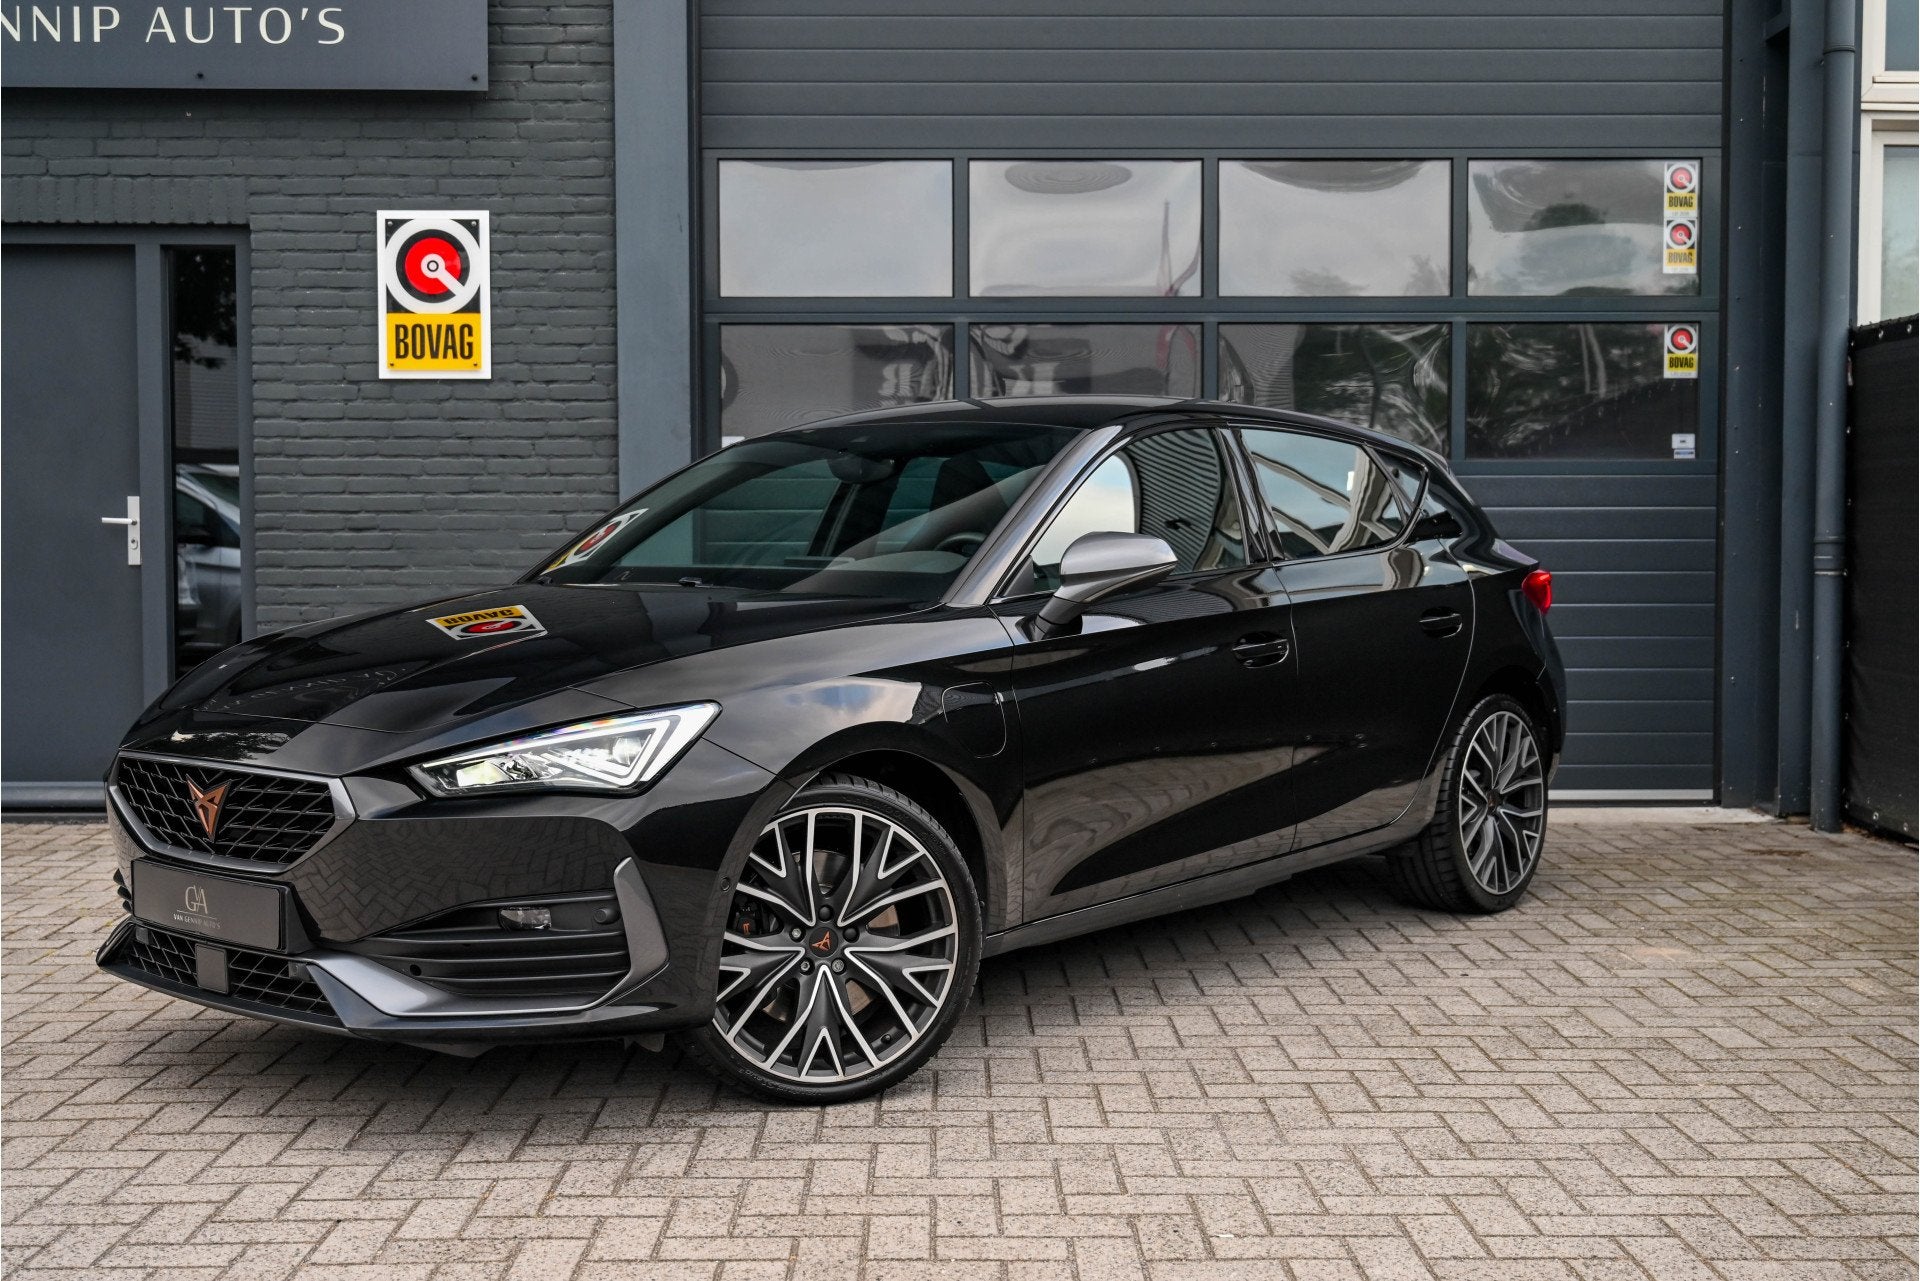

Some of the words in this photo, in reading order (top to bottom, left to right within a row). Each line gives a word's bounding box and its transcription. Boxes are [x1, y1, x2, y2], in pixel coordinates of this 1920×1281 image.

[1, 5, 120, 43] NNIP
[145, 6, 346, 44] AUTO'S
[1668, 195, 1694, 208] BOVAG
[1668, 251, 1693, 264] BOVAG
[394, 323, 474, 360] BOVAG
[1669, 356, 1694, 369] BOVAG
[173, 913, 183, 922] VAN
